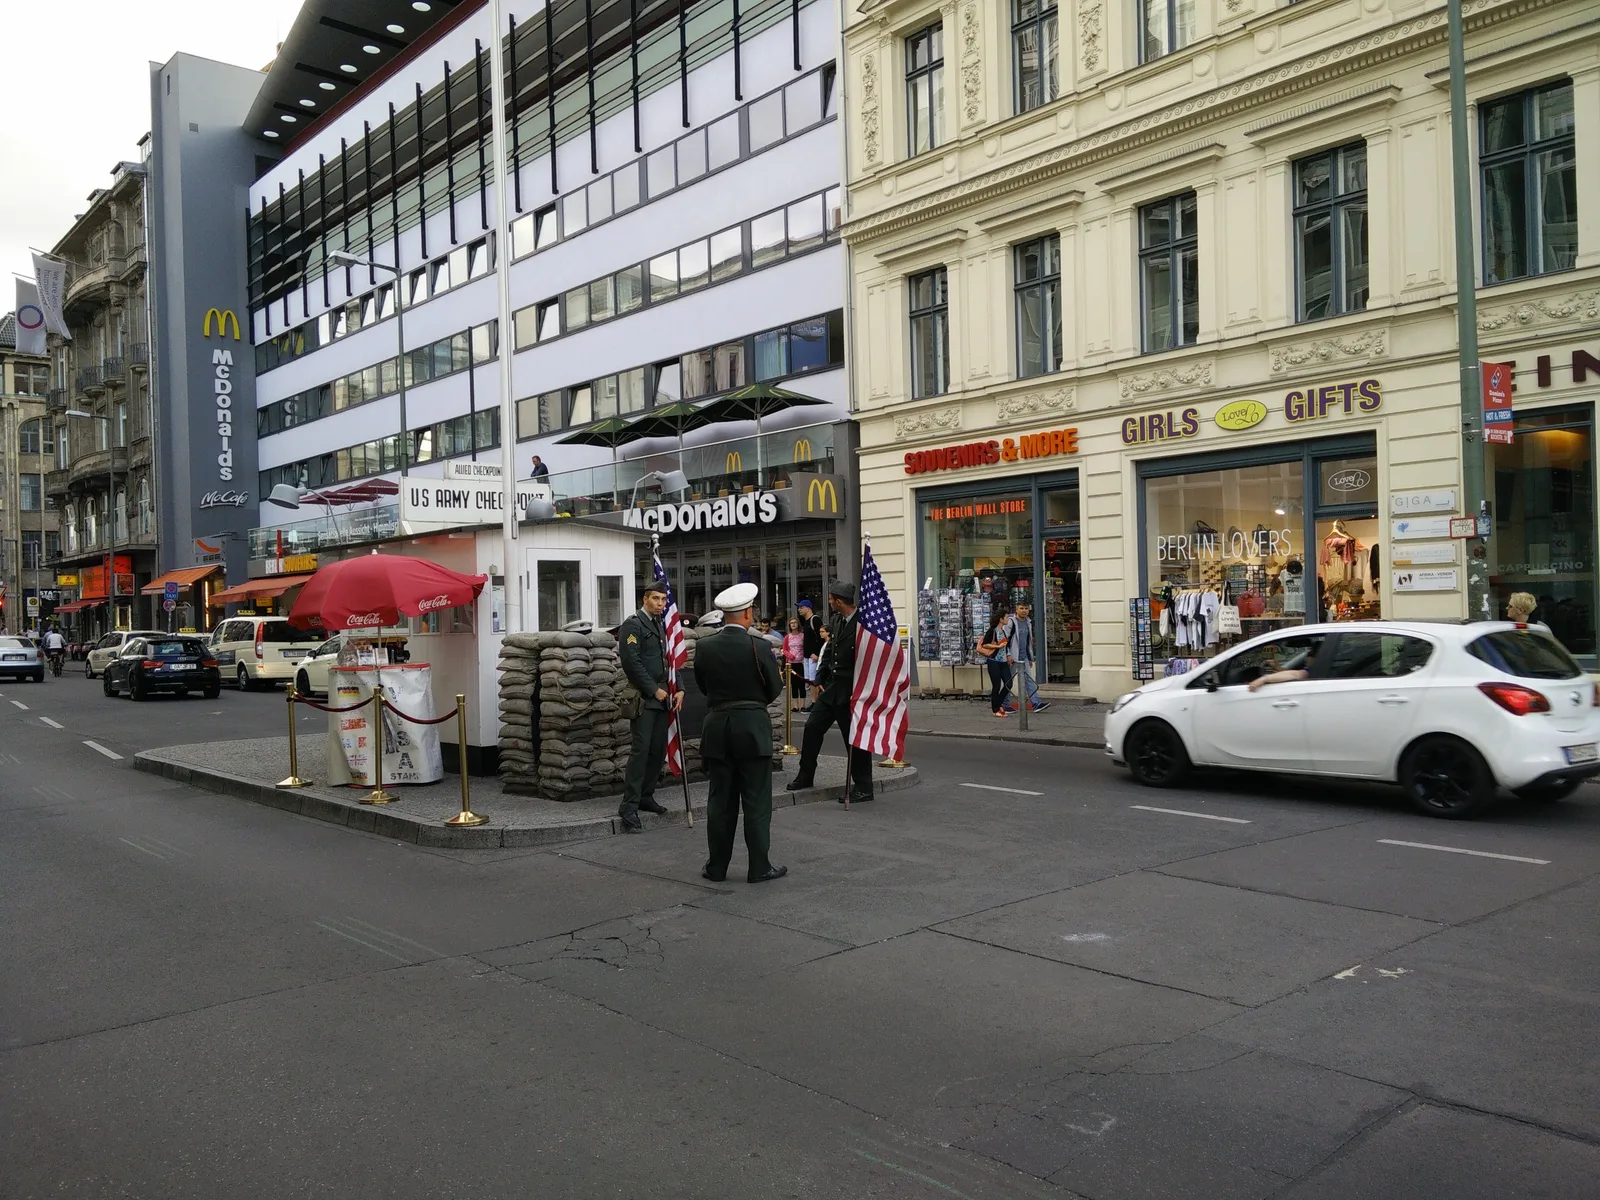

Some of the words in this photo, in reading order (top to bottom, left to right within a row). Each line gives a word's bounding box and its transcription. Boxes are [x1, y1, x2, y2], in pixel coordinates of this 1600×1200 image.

[1284, 379, 1383, 422] GIFTS
[1120, 407, 1200, 445] GIRLS
[904, 439, 1001, 475] SOUVENIRS
[1001, 437, 1018, 463] &
[1019, 427, 1079, 459] MORE
[454, 464, 471, 475] ALLIED
[410, 488, 429, 507] US
[435, 489, 470, 509] ARMY
[623, 491, 778, 533] McDonald's
[930, 507, 943, 521] THE
[946, 504, 973, 519] BERLIN
[975, 502, 997, 517] WALL
[1000, 499, 1026, 514] STORE
[1157, 532, 1218, 561] BERLIN
[1221, 528, 1292, 560] LOVERS
[1498, 561, 1584, 572] CAPPUCCINO
[418, 595, 448, 612] Coca-Cola
[346, 613, 380, 626] Coca-Cola
